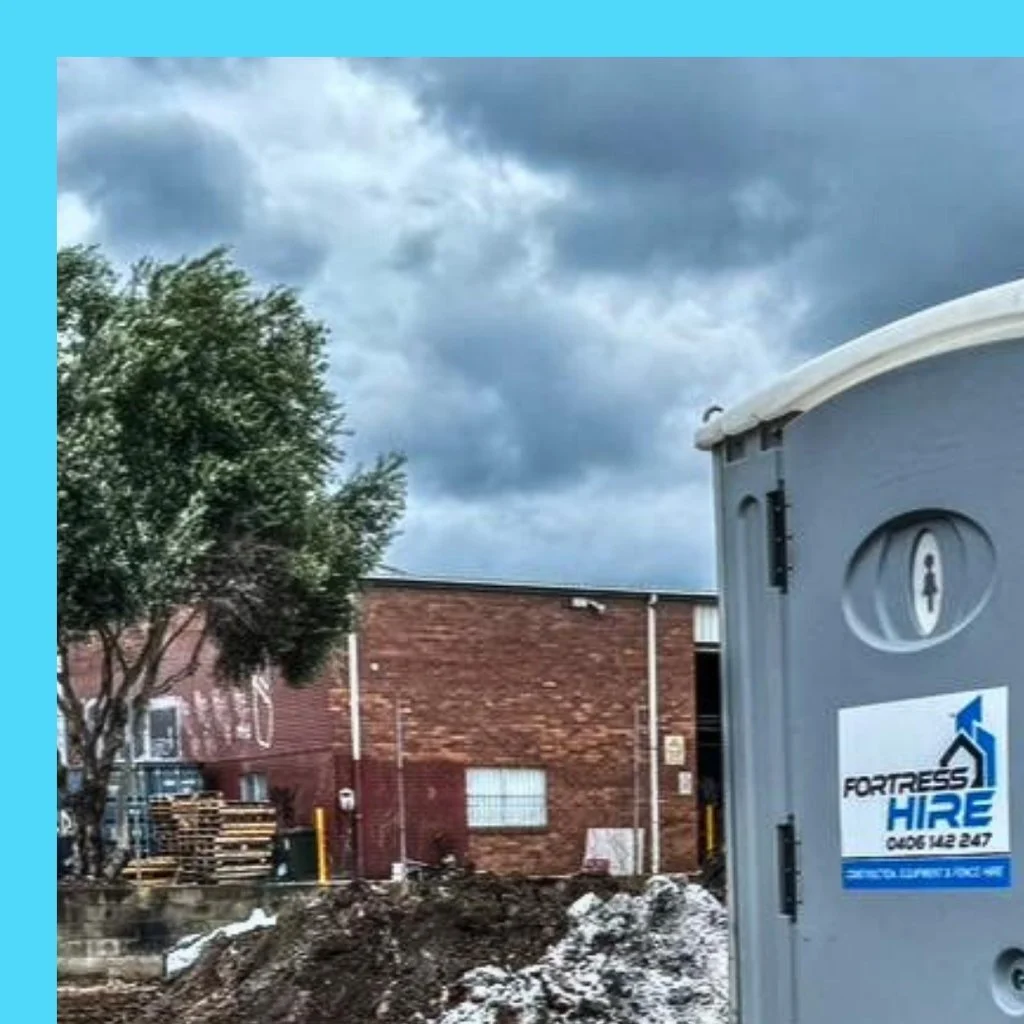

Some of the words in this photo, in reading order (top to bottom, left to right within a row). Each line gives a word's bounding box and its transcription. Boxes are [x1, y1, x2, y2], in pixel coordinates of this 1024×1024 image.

[844, 767, 969, 798] FORTRESS
[886, 791, 996, 831] HIRE
[886, 835, 926, 850] 0406
[928, 834, 957, 849] 142
[959, 833, 993, 848] 247
